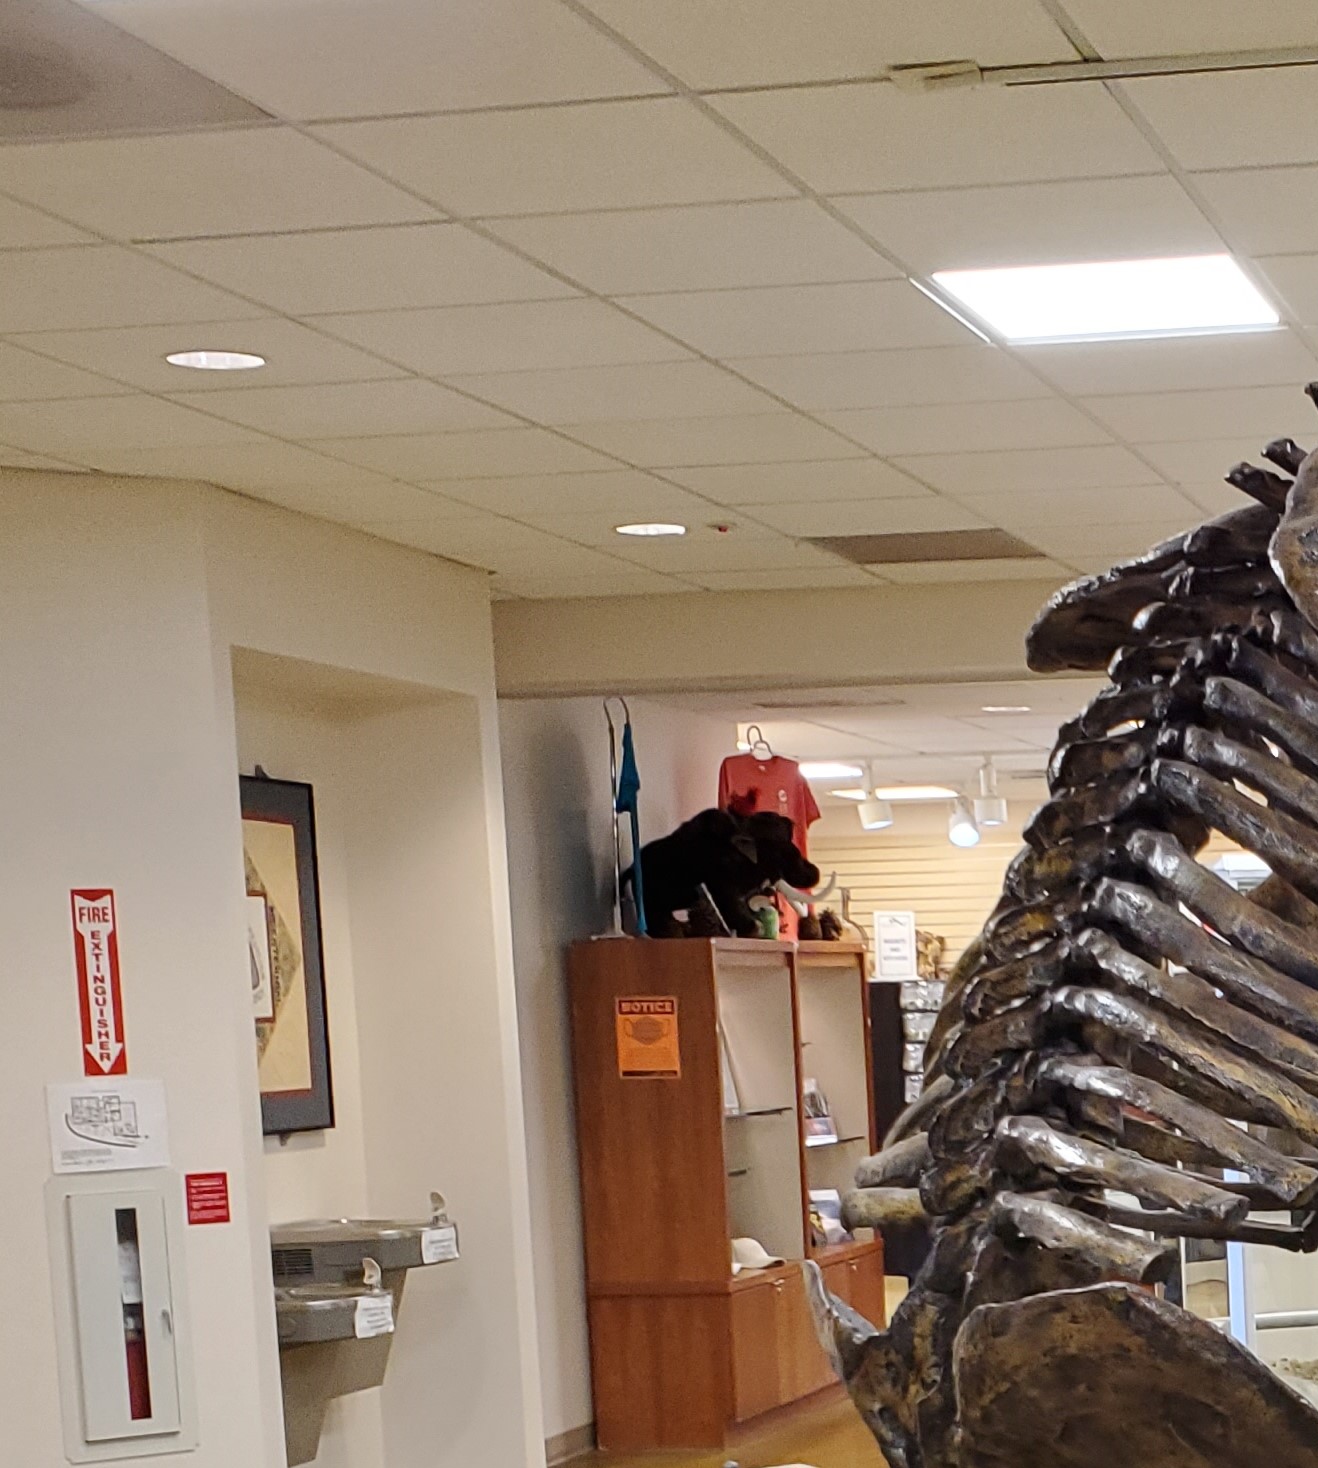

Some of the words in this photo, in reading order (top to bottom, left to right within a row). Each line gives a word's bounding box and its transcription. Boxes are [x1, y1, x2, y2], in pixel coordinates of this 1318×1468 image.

[79, 906, 110, 923] FIRE
[90, 930, 111, 1062] EXTINGUISHER
[621, 1002, 673, 1013] NOTICE
